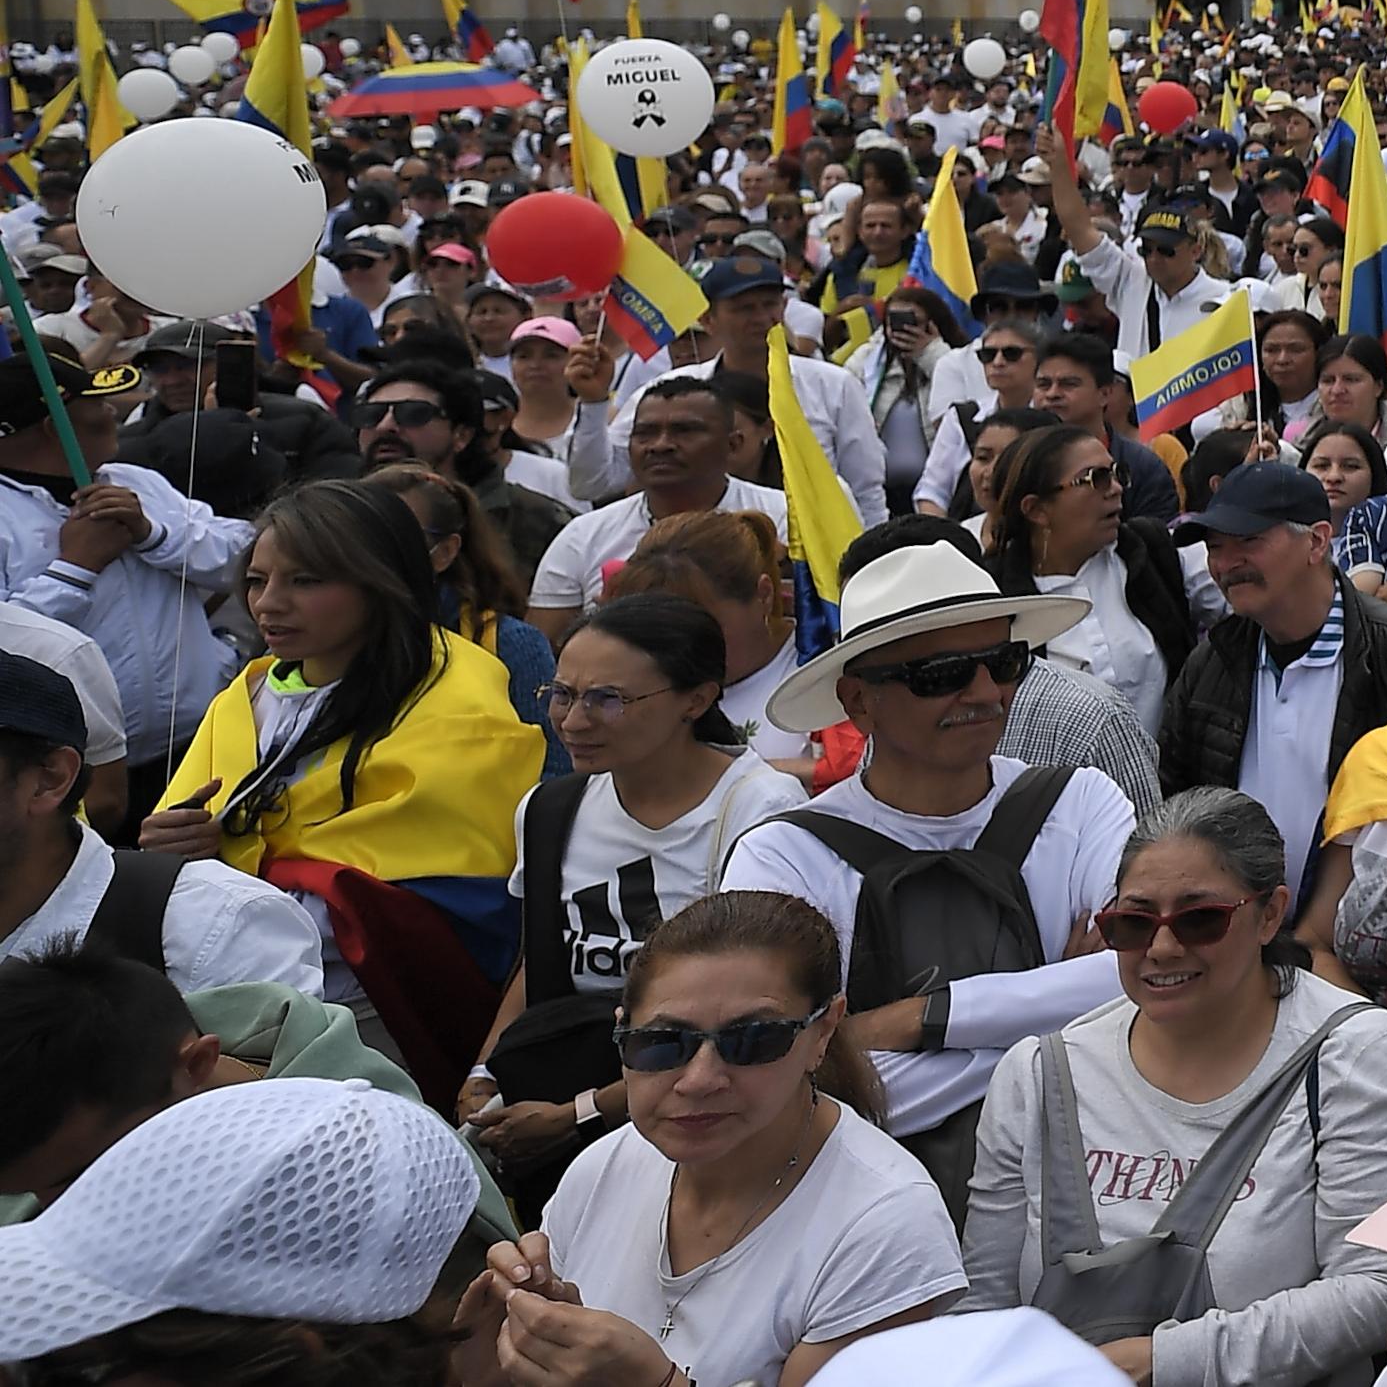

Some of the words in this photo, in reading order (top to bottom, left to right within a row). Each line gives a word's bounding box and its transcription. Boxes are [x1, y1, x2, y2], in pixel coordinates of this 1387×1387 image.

[614, 54, 662, 66] FUERZA
[606, 68, 681, 86] MIGUEL
[617, 287, 664, 335] OMBIA
